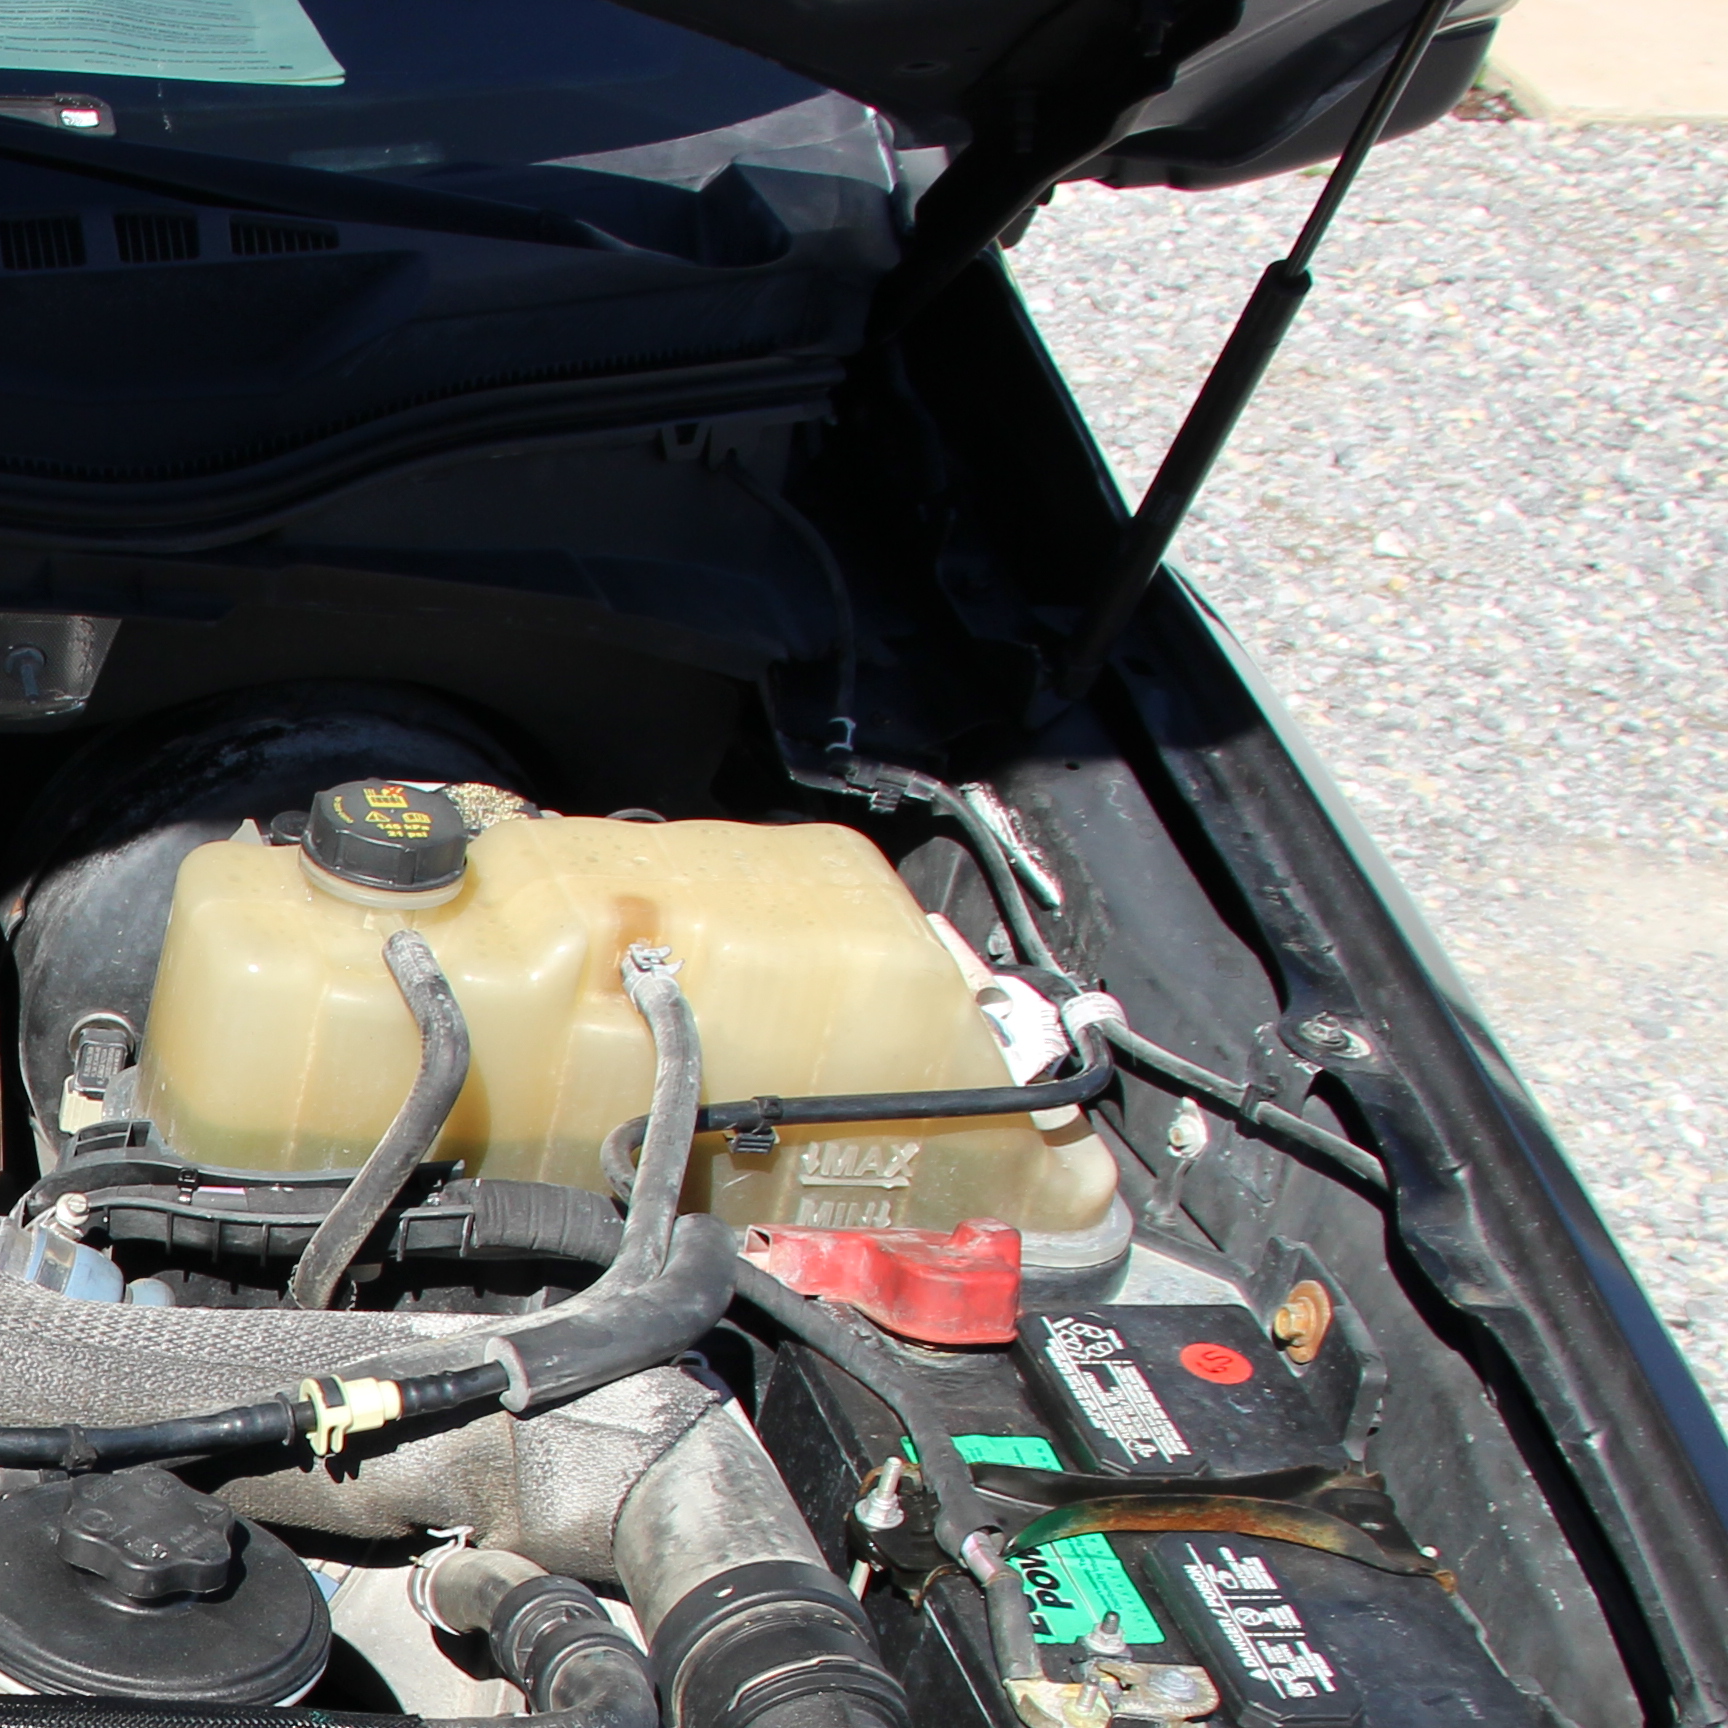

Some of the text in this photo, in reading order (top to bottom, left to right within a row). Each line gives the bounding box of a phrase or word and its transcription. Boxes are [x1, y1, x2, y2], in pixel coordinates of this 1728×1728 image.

[819, 1141, 921, 1178] MAX
[795, 1197, 877, 1227] MIN
[1182, 1563, 1224, 1607] POISON
[1217, 1618, 1262, 1667] DANGER
